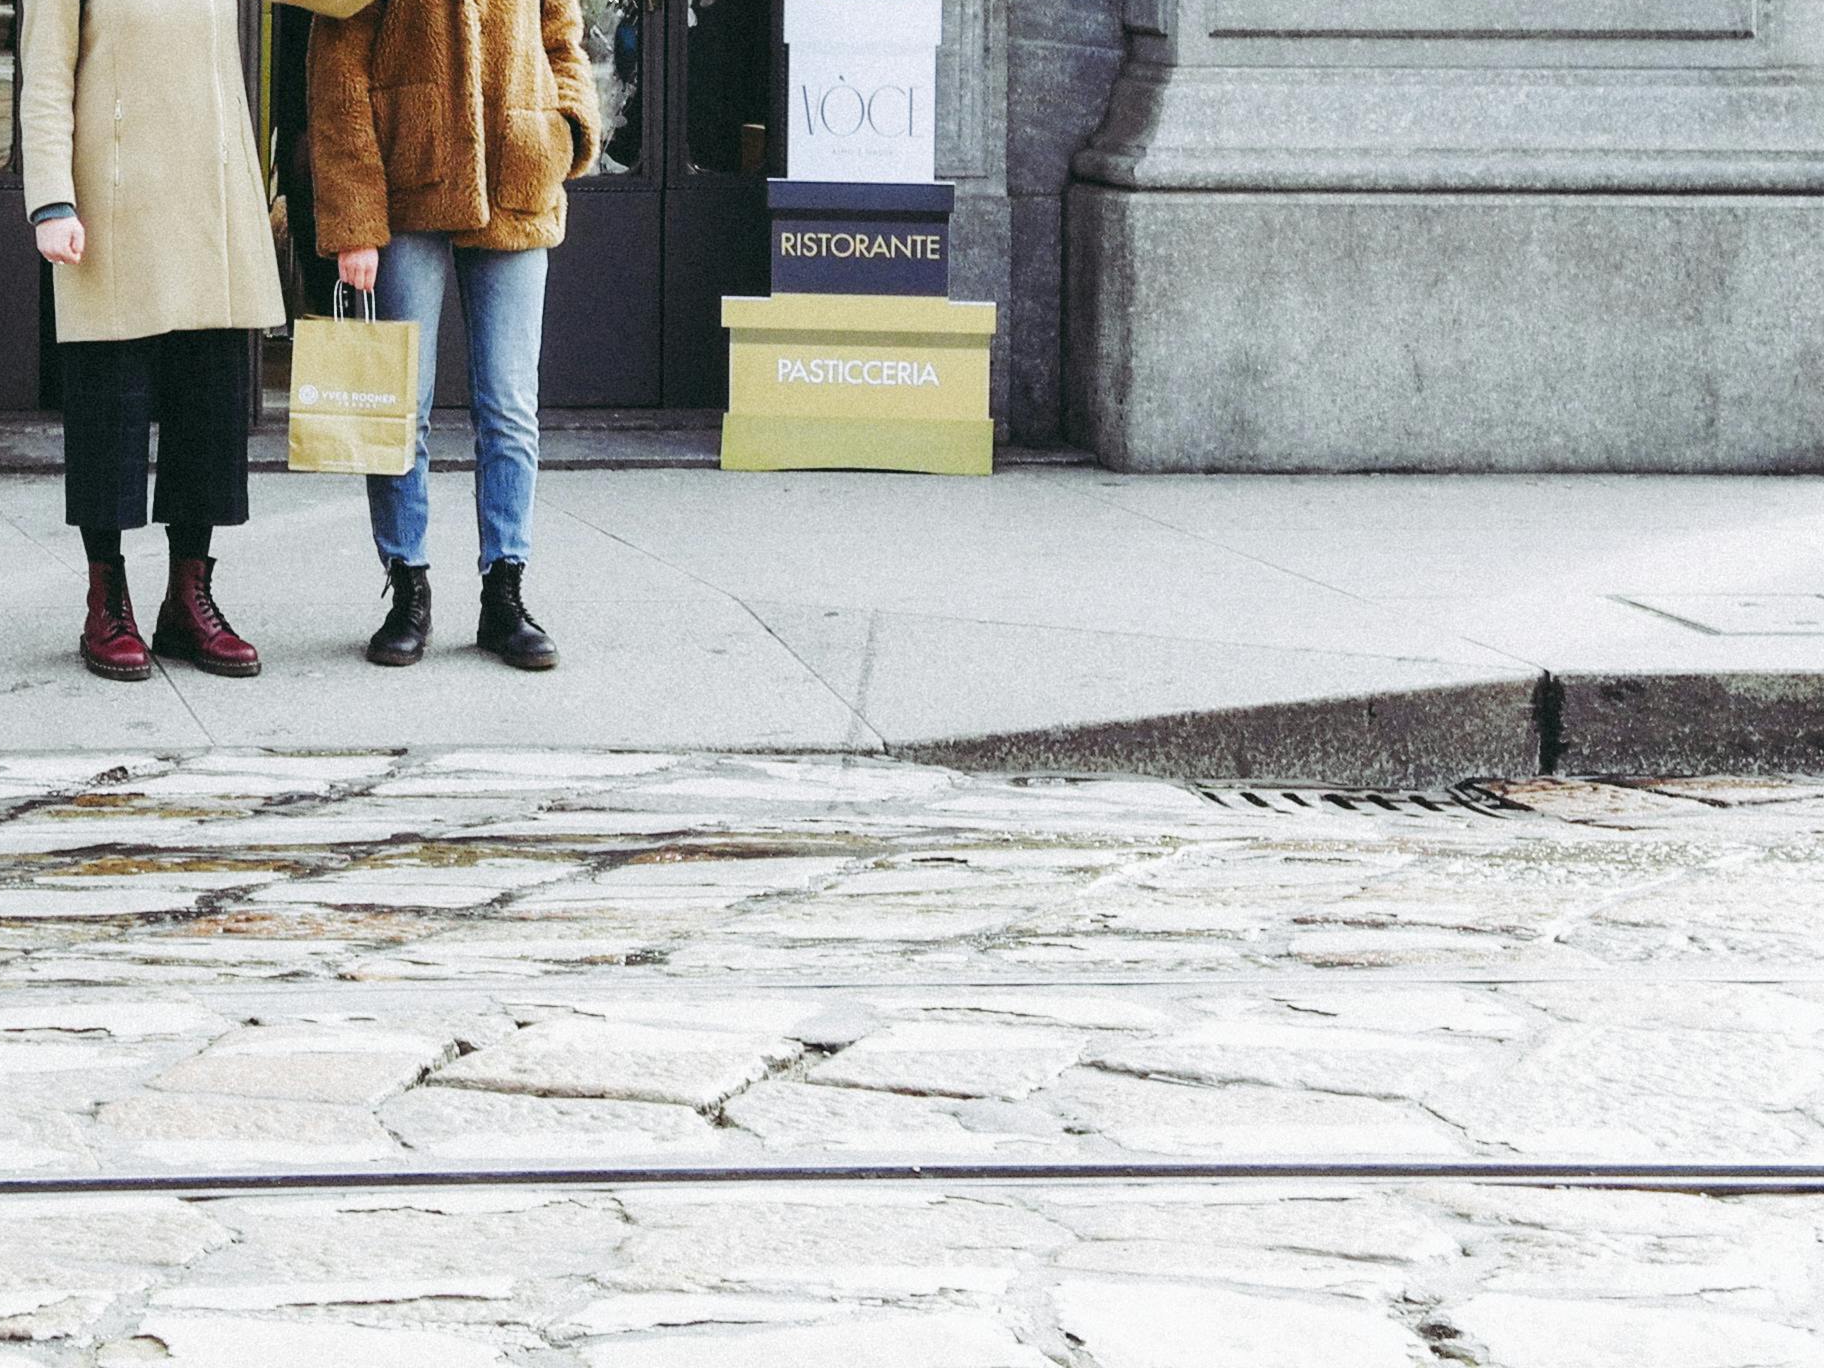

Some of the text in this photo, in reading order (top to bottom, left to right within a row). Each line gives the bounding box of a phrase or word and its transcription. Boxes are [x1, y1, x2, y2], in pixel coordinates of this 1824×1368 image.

[781, 232, 940, 260] RISTORANTE
[778, 359, 939, 386] PASTICCERIA
[322, 391, 349, 402] YVES
